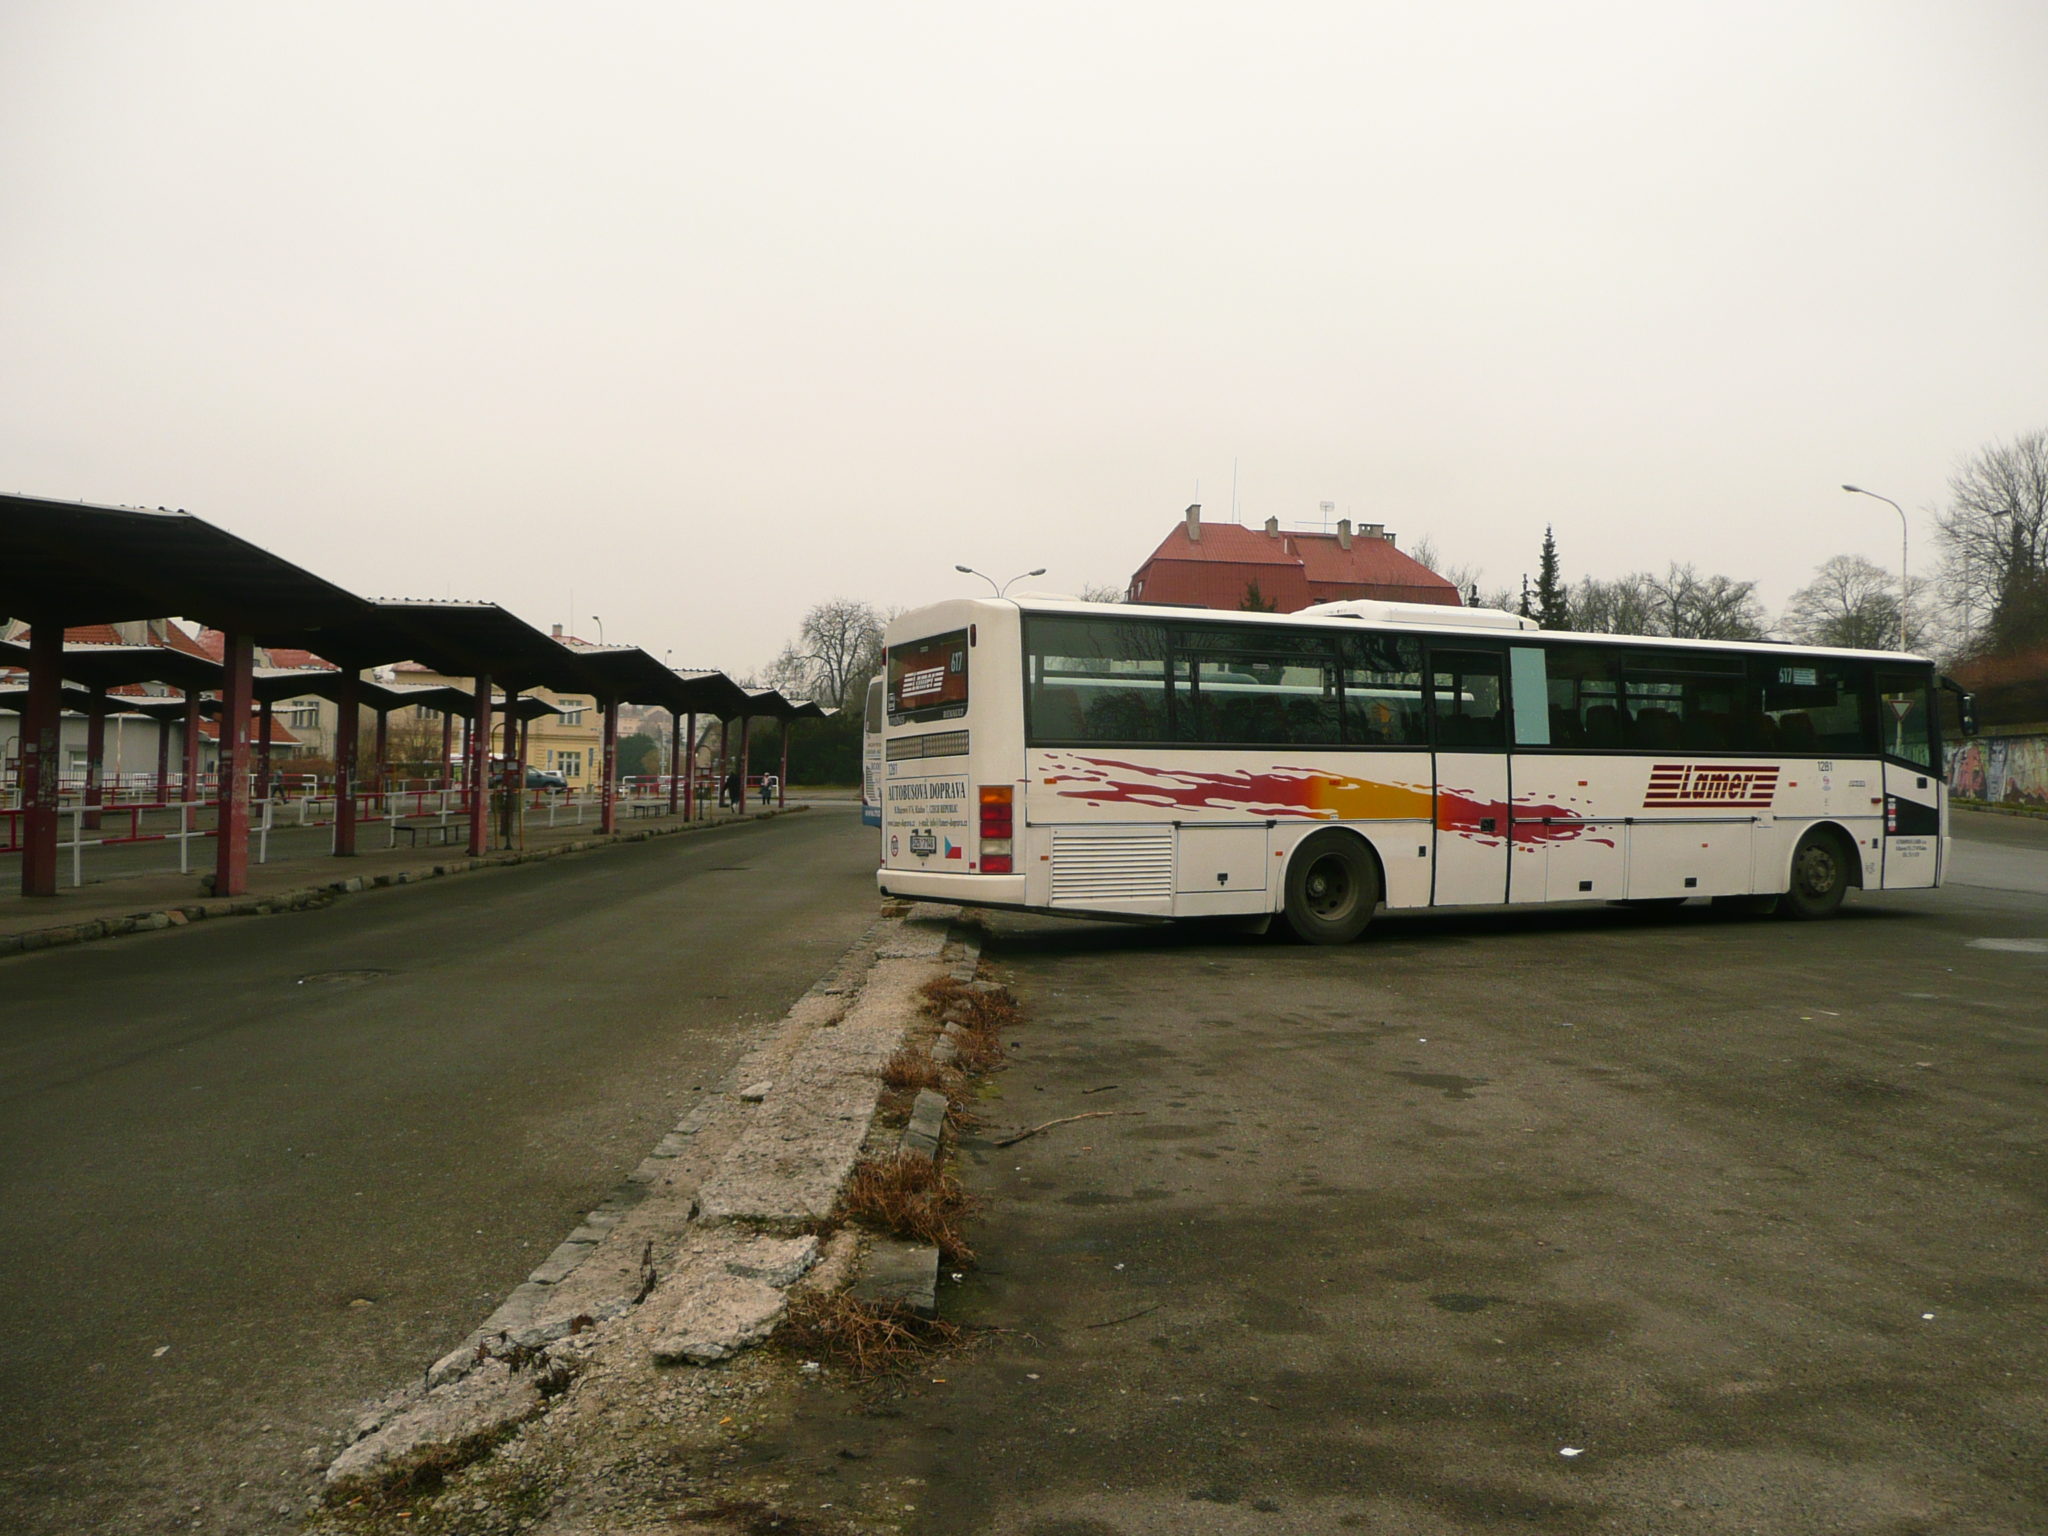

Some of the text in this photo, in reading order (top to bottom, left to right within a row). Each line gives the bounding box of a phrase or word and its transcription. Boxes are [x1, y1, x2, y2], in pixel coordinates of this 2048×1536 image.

[951, 651, 962, 672] 617
[1817, 761, 1833, 772] 1281
[930, 782, 966, 800] DOPRAVA
[1679, 764, 1755, 800] Lamer
